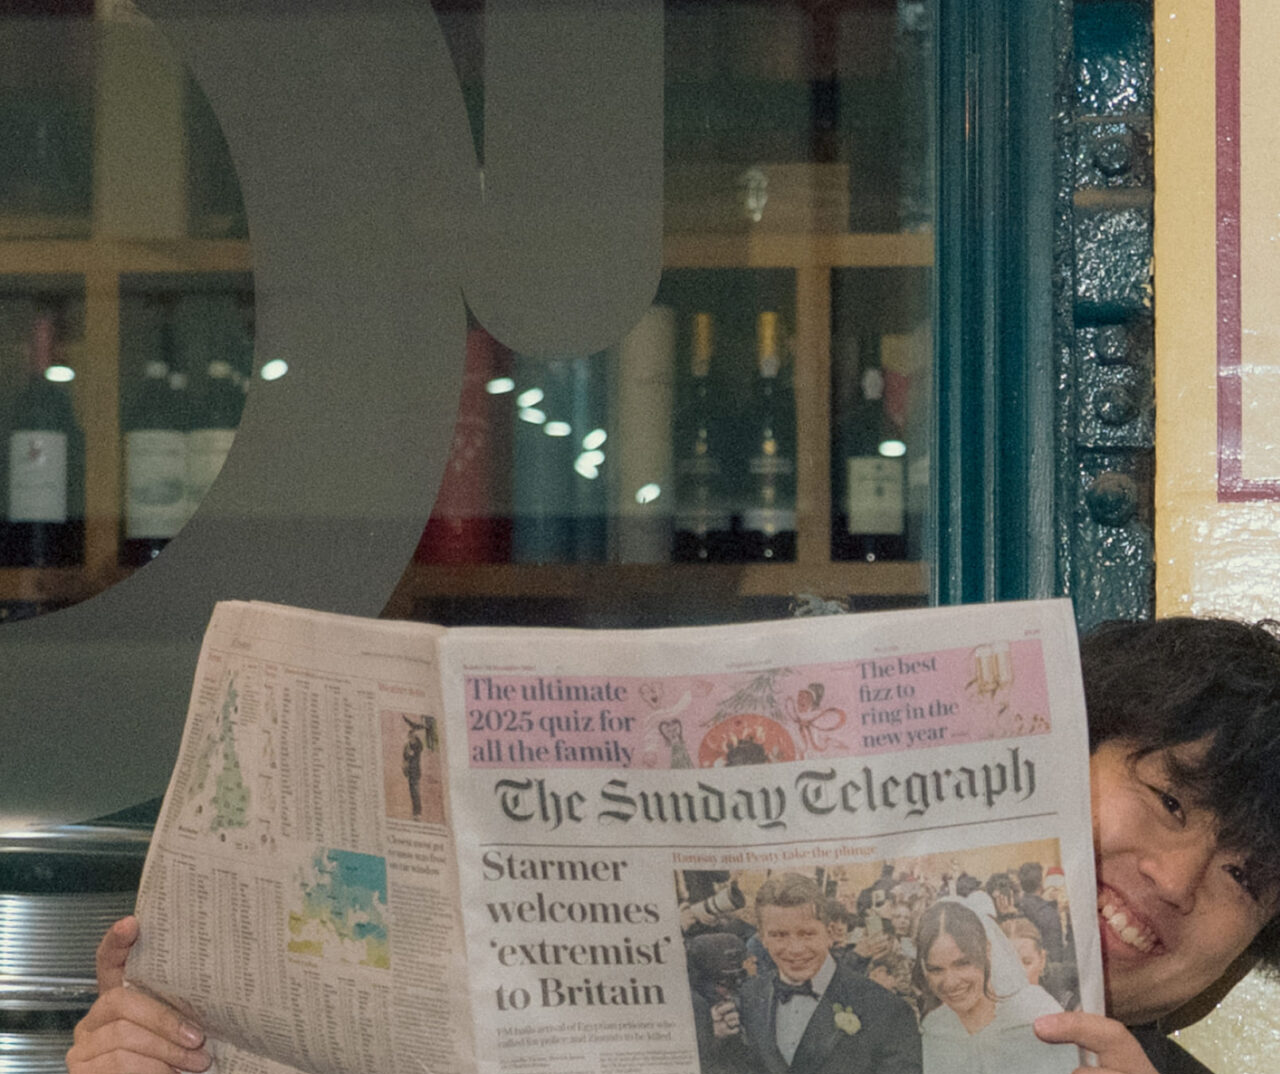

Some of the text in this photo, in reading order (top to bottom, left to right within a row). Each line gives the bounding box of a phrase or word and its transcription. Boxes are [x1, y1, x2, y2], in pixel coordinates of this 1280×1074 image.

[857, 656, 937, 681] The best
[468, 677, 628, 702] The ultimate
[859, 684, 915, 704] fizz to
[470, 709, 637, 738] 2025 quiz for
[861, 699, 959, 728] ring in the
[862, 727, 949, 749] new year
[472, 739, 635, 768] all the family
[494, 747, 1038, 831] The Sunday Telegraph
[482, 850, 628, 884] Starmer
[487, 892, 661, 927] welcomes
[490, 935, 672, 968] ‘extremist’
[495, 975, 667, 1014] to Britain
